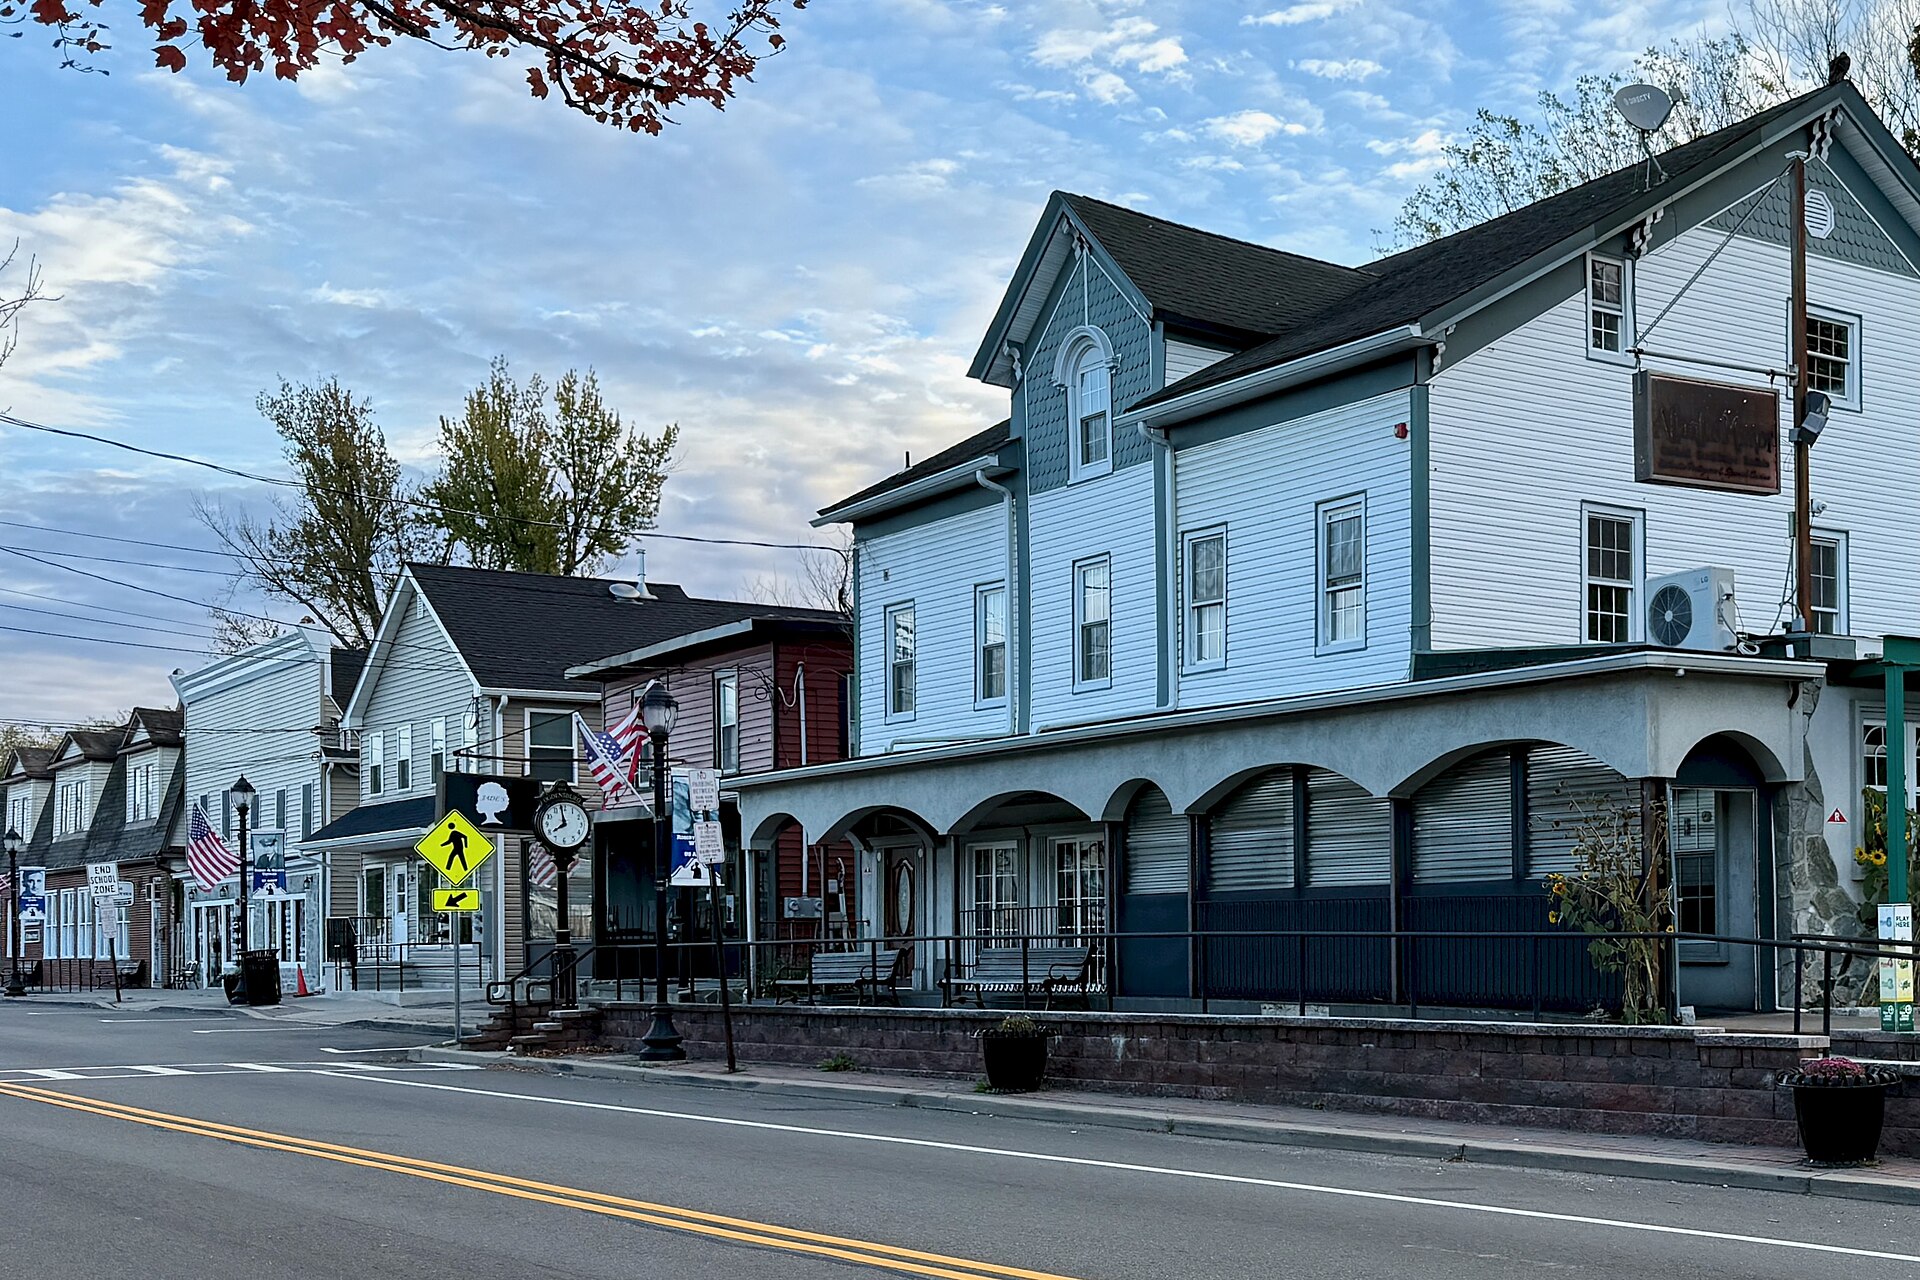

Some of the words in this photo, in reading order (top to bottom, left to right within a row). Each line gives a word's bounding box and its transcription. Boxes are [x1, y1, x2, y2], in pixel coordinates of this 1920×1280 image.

[1700, 576, 1709, 584] LG
[696, 772, 707, 780] NO
[1834, 812, 1841, 822] R
[94, 866, 111, 875] END
[90, 875, 116, 885] SCHOOL
[94, 885, 116, 894] ZONE
